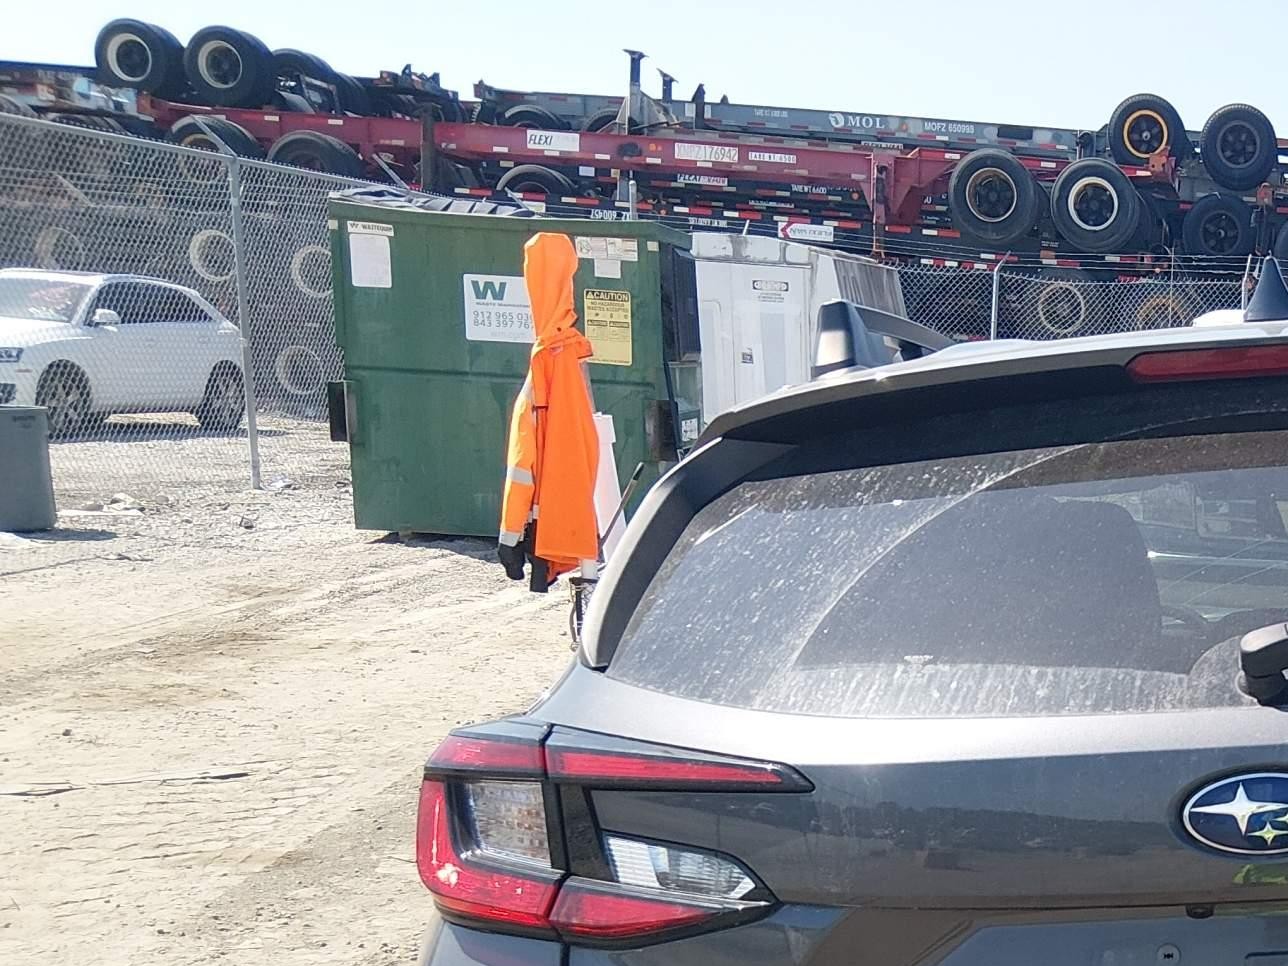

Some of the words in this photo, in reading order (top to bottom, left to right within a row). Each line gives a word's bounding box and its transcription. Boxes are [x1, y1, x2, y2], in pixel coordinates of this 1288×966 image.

[847, 115, 885, 128] MOL
[924, 121, 946, 132] MOFZ
[528, 133, 553, 146] FLEXI
[593, 291, 628, 301] CAUTION
[473, 310, 492, 319] 912
[495, 311, 514, 320] 965
[473, 318, 492, 328] 843
[495, 319, 514, 329] 397
